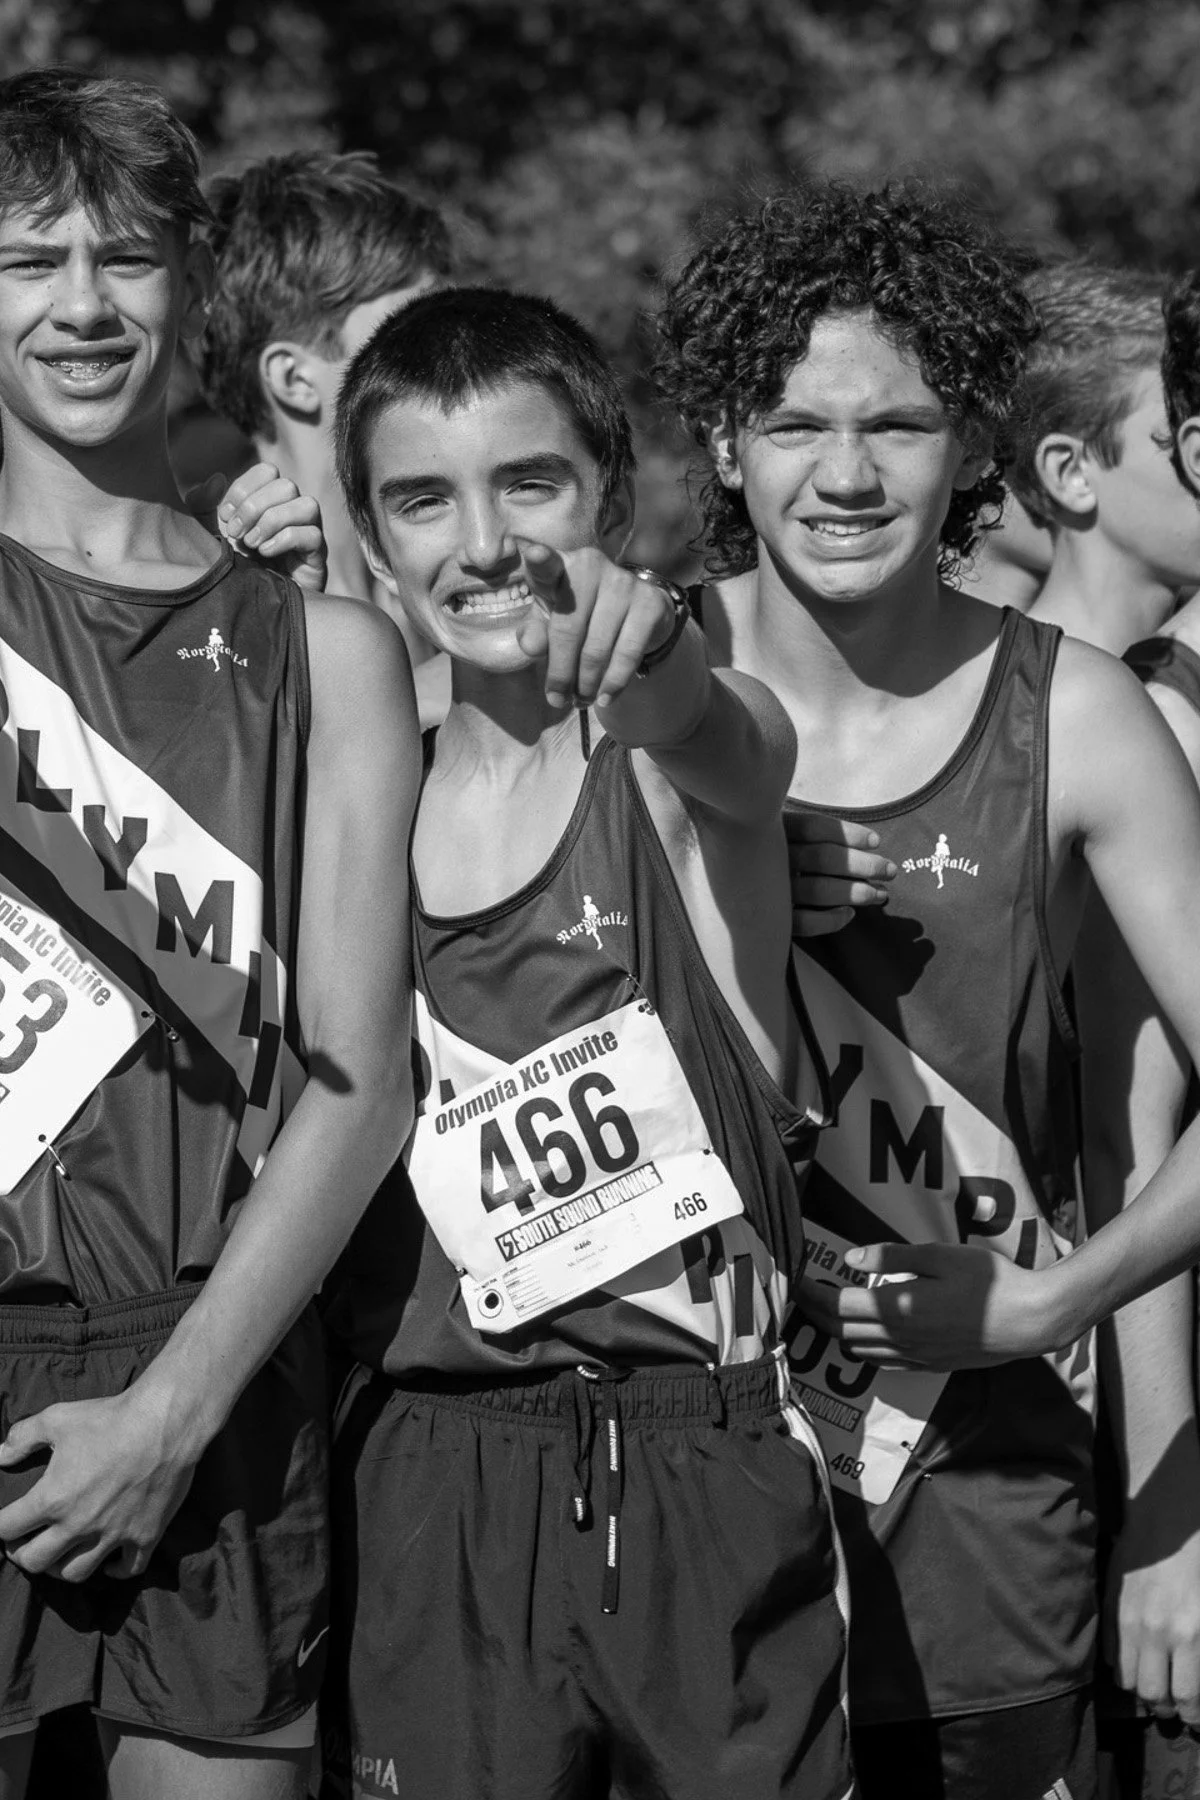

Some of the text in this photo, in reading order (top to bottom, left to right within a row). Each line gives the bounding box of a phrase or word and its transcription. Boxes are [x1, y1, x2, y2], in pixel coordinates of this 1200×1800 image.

[22, 921, 58, 957] XC
[50, 947, 112, 1007] Invite
[435, 1030, 619, 1136] Olympia XC Invite
[480, 1072, 640, 1217] 466
[514, 1165, 660, 1251] SOUTH SOUND RUNNING
[672, 1191, 709, 1222] 466
[830, 1453, 866, 1480] 469
